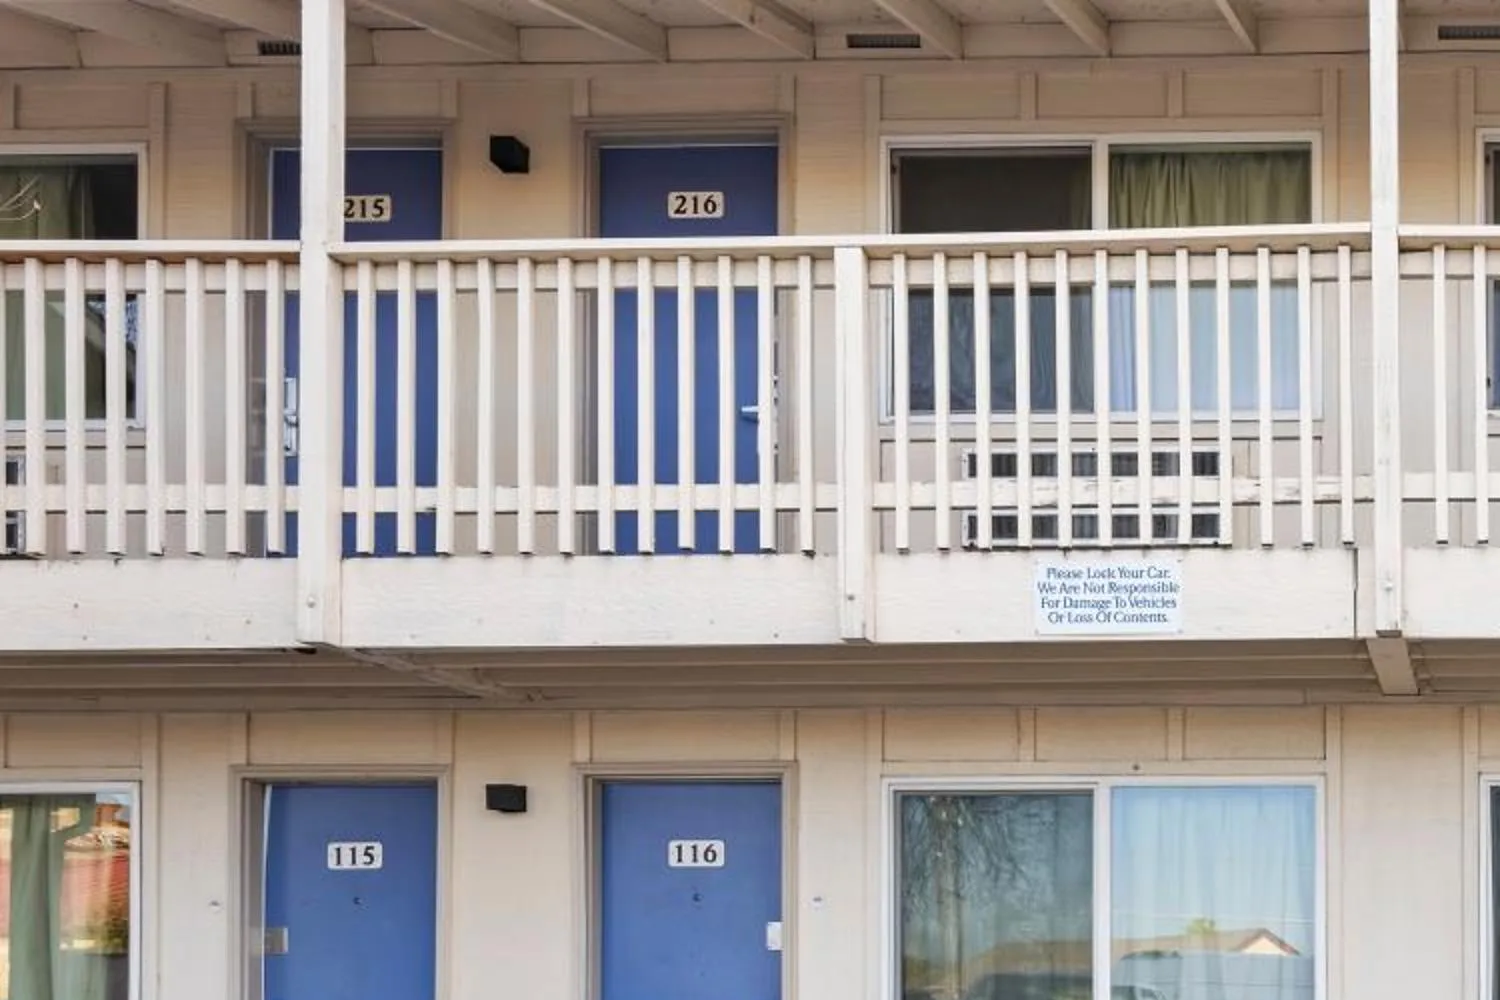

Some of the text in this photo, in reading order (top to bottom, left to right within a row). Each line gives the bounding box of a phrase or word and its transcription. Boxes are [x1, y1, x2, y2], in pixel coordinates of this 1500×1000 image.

[344, 198, 384, 219] 215
[674, 195, 717, 216] 216
[1047, 567, 1083, 579] Please
[1087, 567, 1116, 579] Lock
[1117, 567, 1144, 579] Your
[1037, 581, 1180, 597] We Are Not Responsible
[1041, 596, 1177, 611] For Damage To Vehicles
[1047, 611, 1064, 624] Or
[1067, 612, 1093, 624] Loss
[1095, 611, 1112, 624] Of
[334, 846, 376, 865] 115
[674, 843, 717, 864] 116
